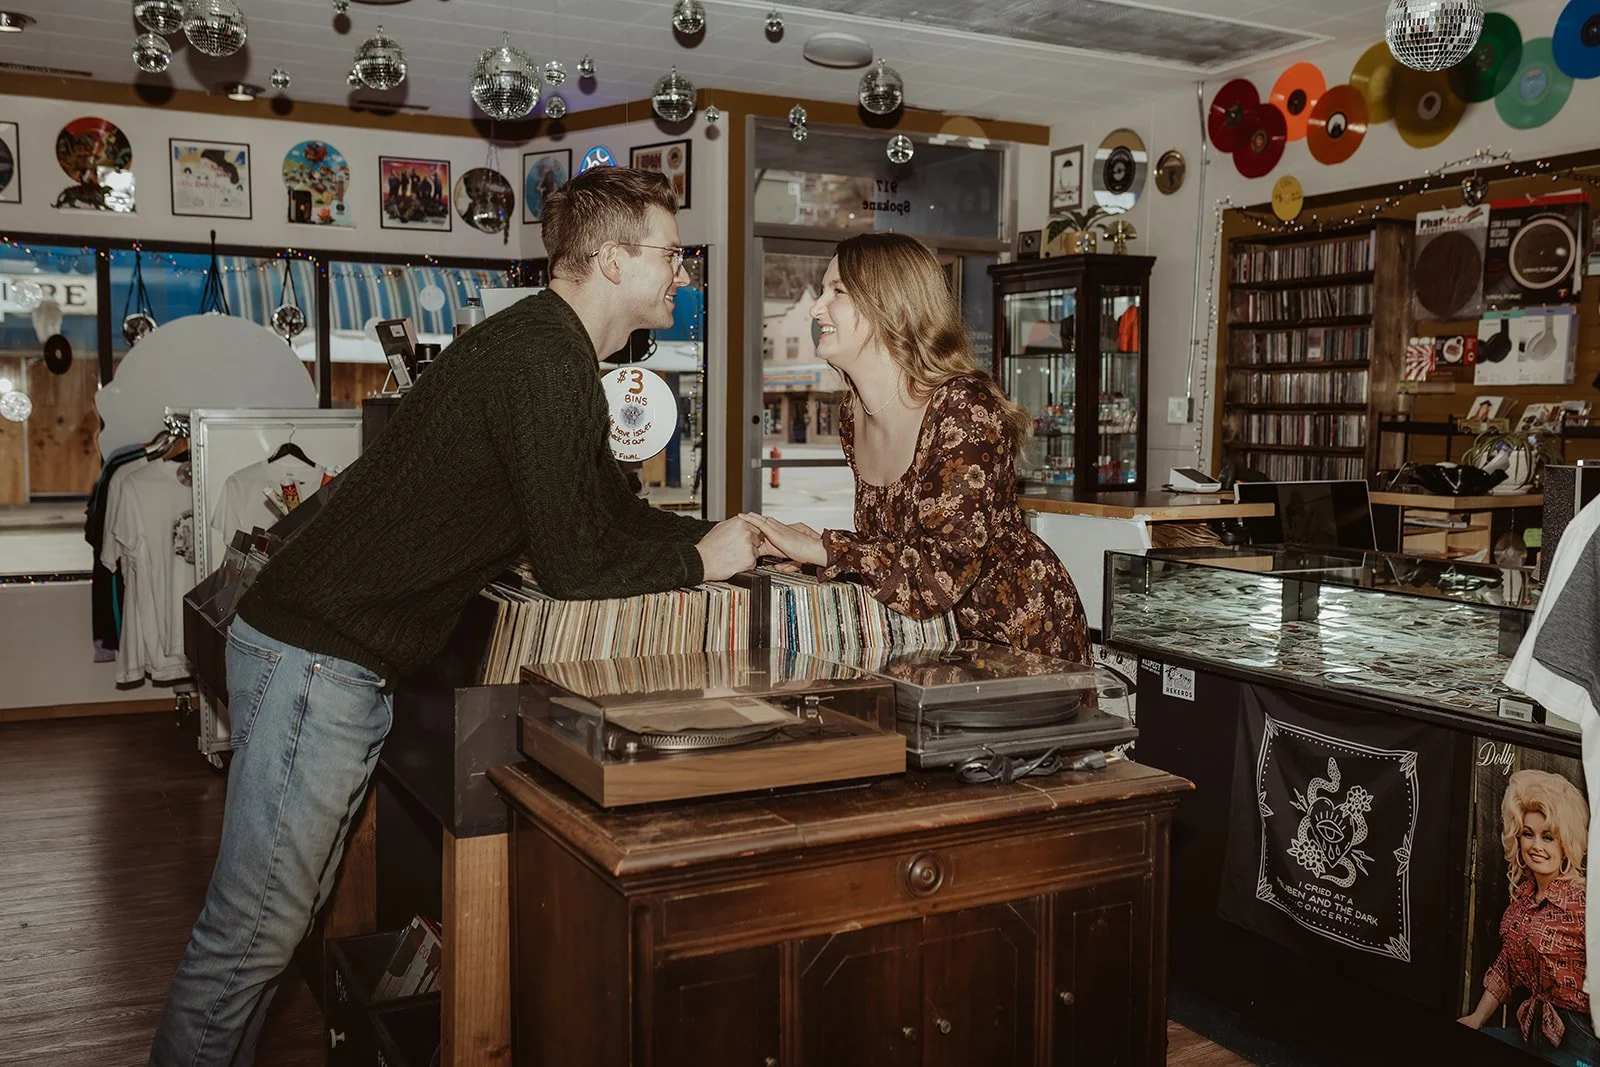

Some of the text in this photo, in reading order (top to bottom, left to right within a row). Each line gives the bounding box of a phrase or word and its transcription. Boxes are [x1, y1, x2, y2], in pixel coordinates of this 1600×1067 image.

[624, 394, 648, 406] BINS
[615, 426, 630, 437] have
[633, 421, 652, 437] issues
[1165, 687, 1193, 698] REKERDS
[1476, 741, 1516, 776] Dolly
[1304, 883, 1332, 897] CRIED
[1333, 893, 1346, 901] AT
[1308, 895, 1332, 908] AND
[1334, 902, 1354, 916] THE
[1355, 910, 1379, 927] DARK
